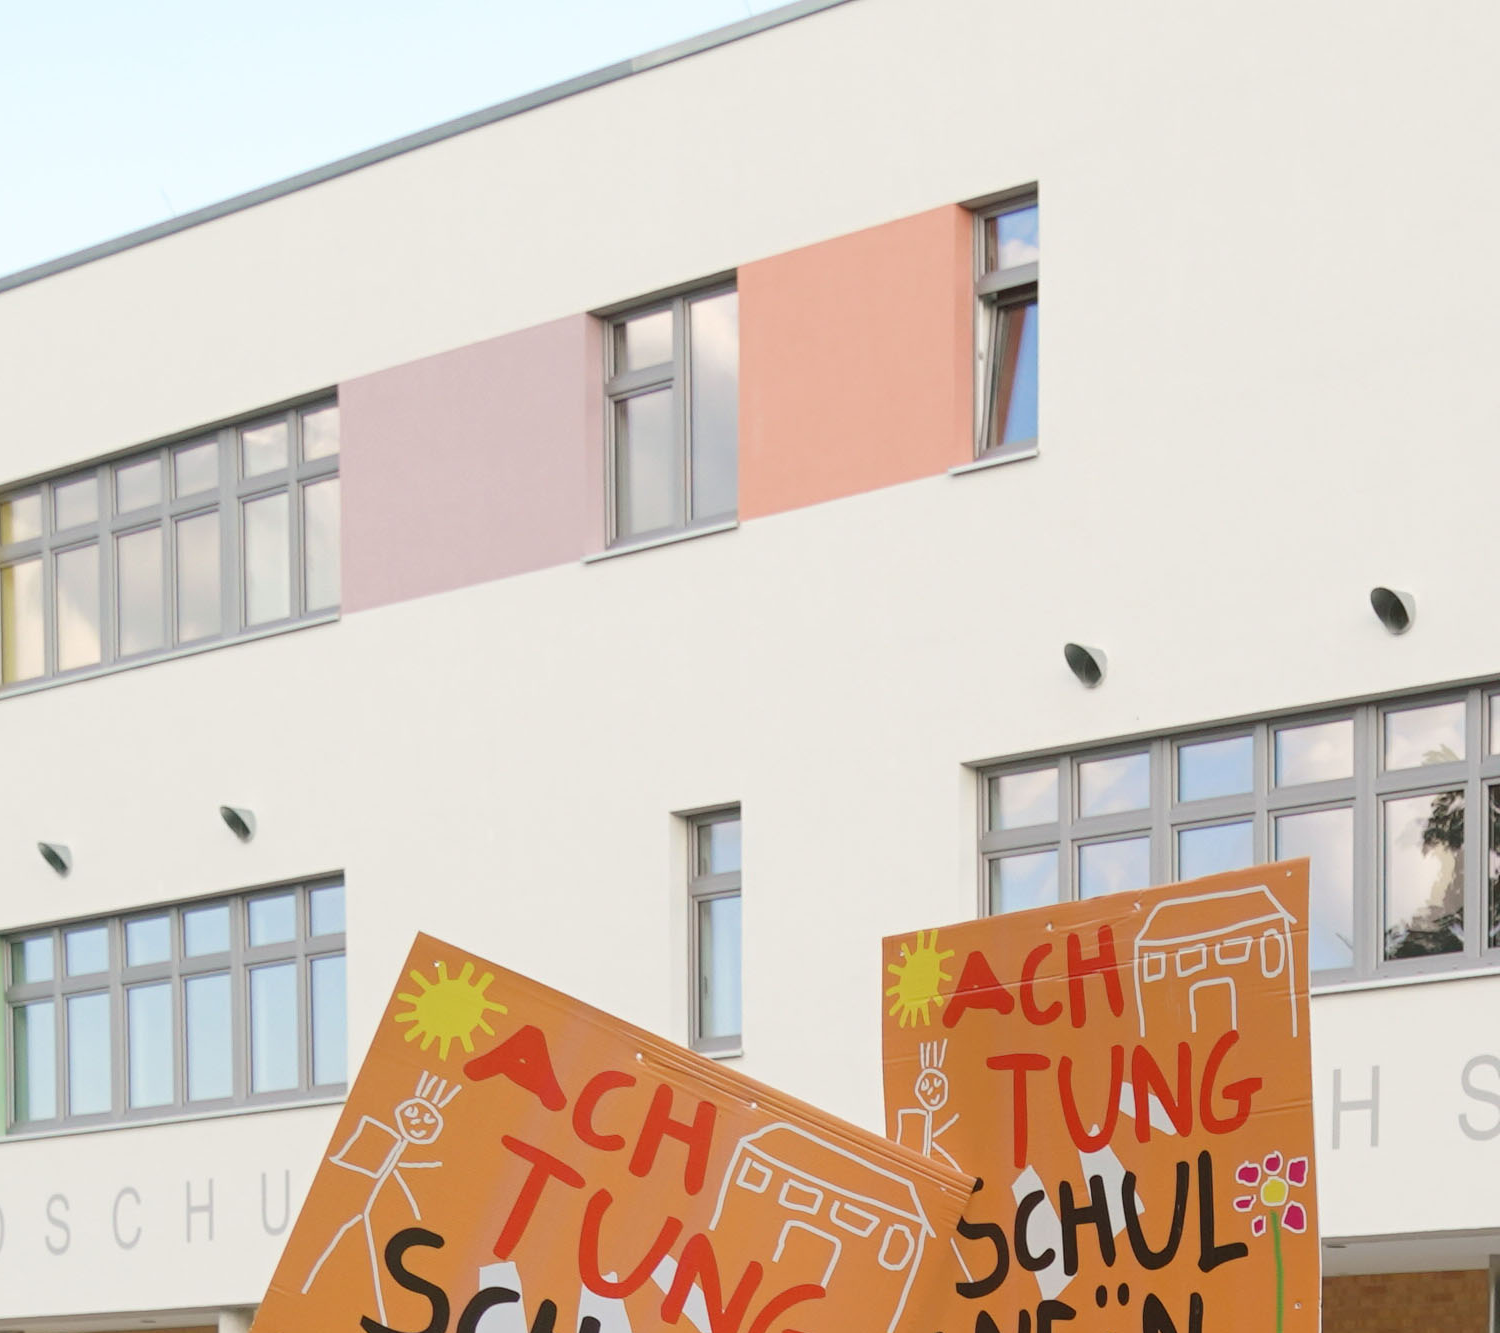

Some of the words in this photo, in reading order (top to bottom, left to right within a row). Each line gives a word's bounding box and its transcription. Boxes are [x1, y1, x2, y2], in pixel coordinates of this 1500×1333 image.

[942, 924, 1125, 1029] ACH
[463, 1024, 717, 1198] ACH
[987, 1030, 1263, 1170] TUNG
[954, 1151, 1249, 1299] SCHUL
